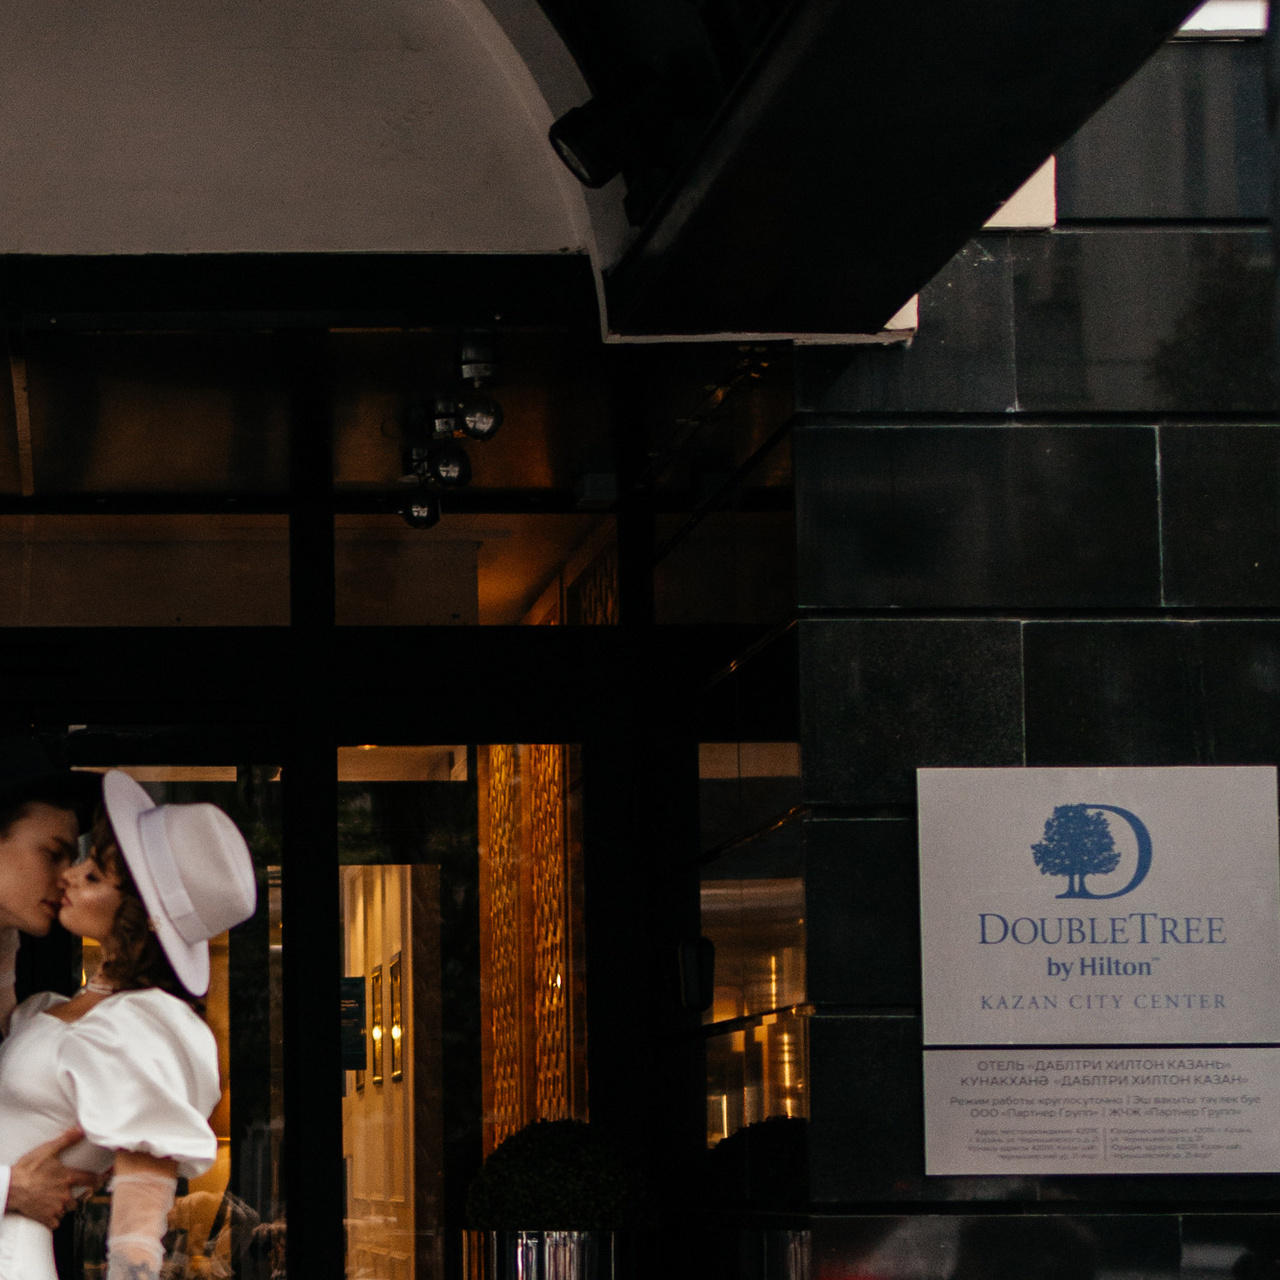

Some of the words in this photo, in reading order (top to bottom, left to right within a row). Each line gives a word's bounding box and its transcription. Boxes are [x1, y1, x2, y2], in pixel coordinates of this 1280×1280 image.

[1047, 957, 1074, 981] by
[981, 995, 1058, 1010] KAZAN
[1070, 994, 1123, 1010] CITY
[1134, 994, 1227, 1010] CENTER
[977, 1060, 1024, 1072] ОТЕЛЬ
[1106, 1059, 1164, 1071] ХИЛТОН
[1132, 1075, 1190, 1086] ХИЛТОН
